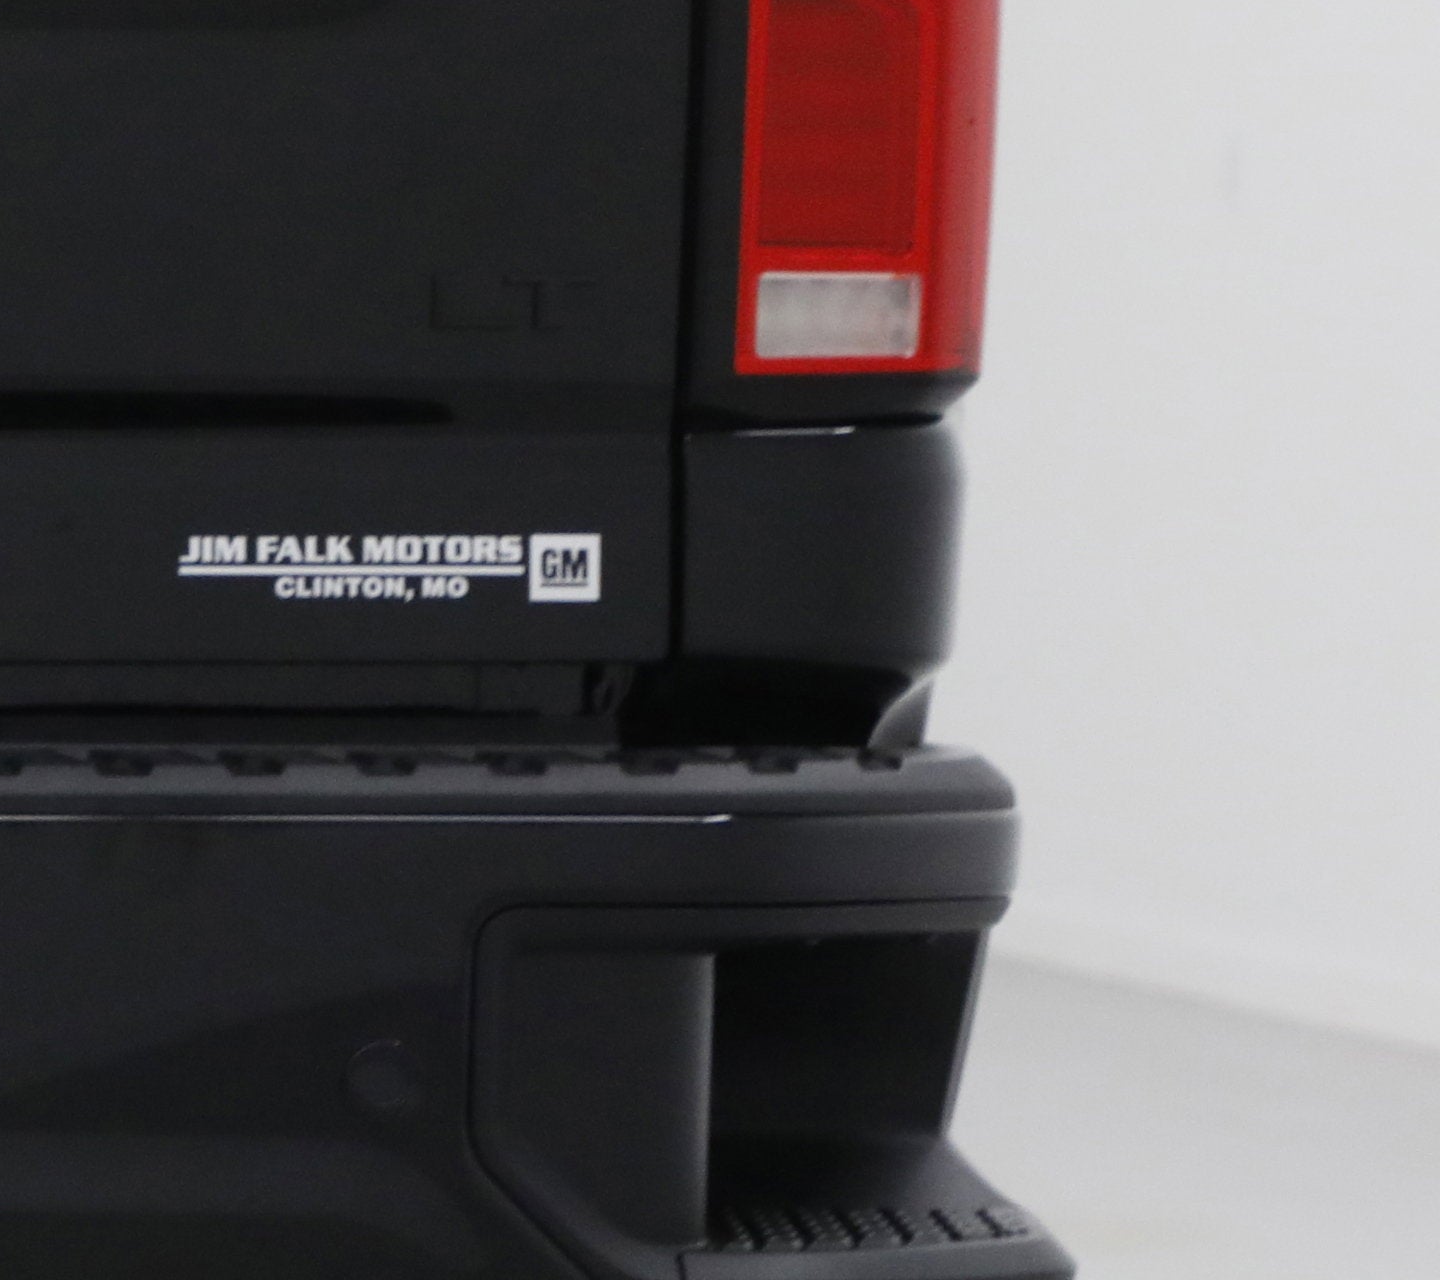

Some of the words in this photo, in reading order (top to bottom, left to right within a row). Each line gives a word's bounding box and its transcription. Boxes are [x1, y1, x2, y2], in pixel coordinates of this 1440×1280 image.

[179, 534, 248, 564] JIM
[255, 534, 356, 564] FALK
[361, 534, 523, 565] MOTORS
[540, 548, 590, 582] GM
[274, 576, 416, 603] CLINTON,
[420, 576, 471, 601] MO
